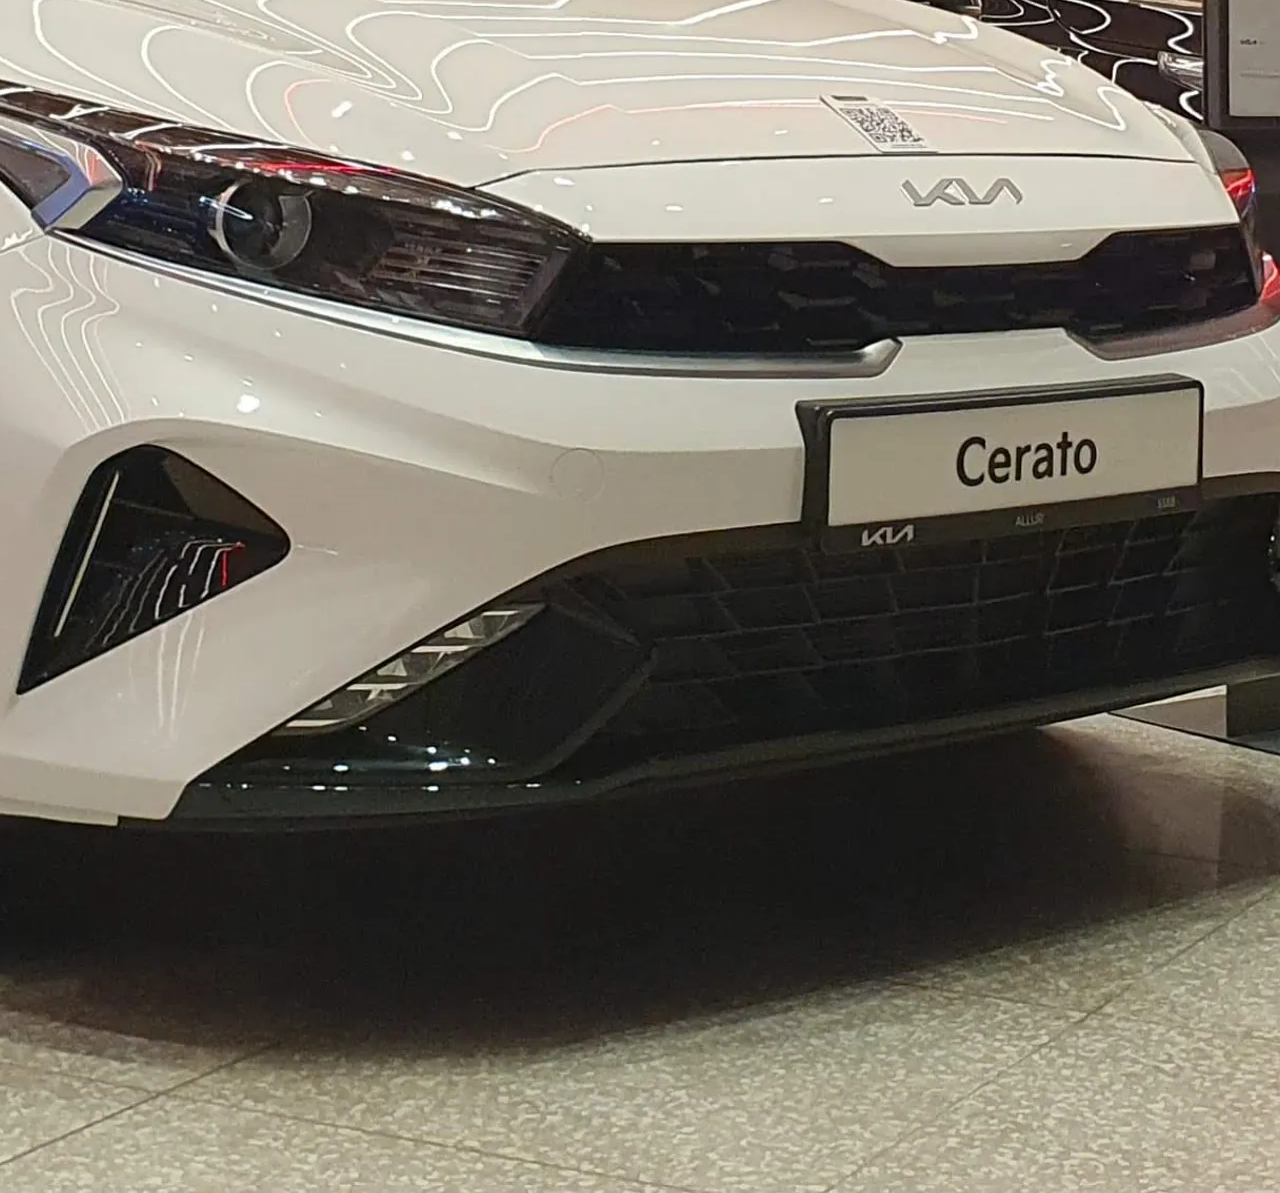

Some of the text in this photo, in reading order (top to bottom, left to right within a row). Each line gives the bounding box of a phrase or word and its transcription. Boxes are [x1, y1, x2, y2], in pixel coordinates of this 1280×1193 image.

[900, 177, 1023, 207] KIA
[956, 431, 1098, 487] Cerato
[861, 524, 915, 547] KIA
